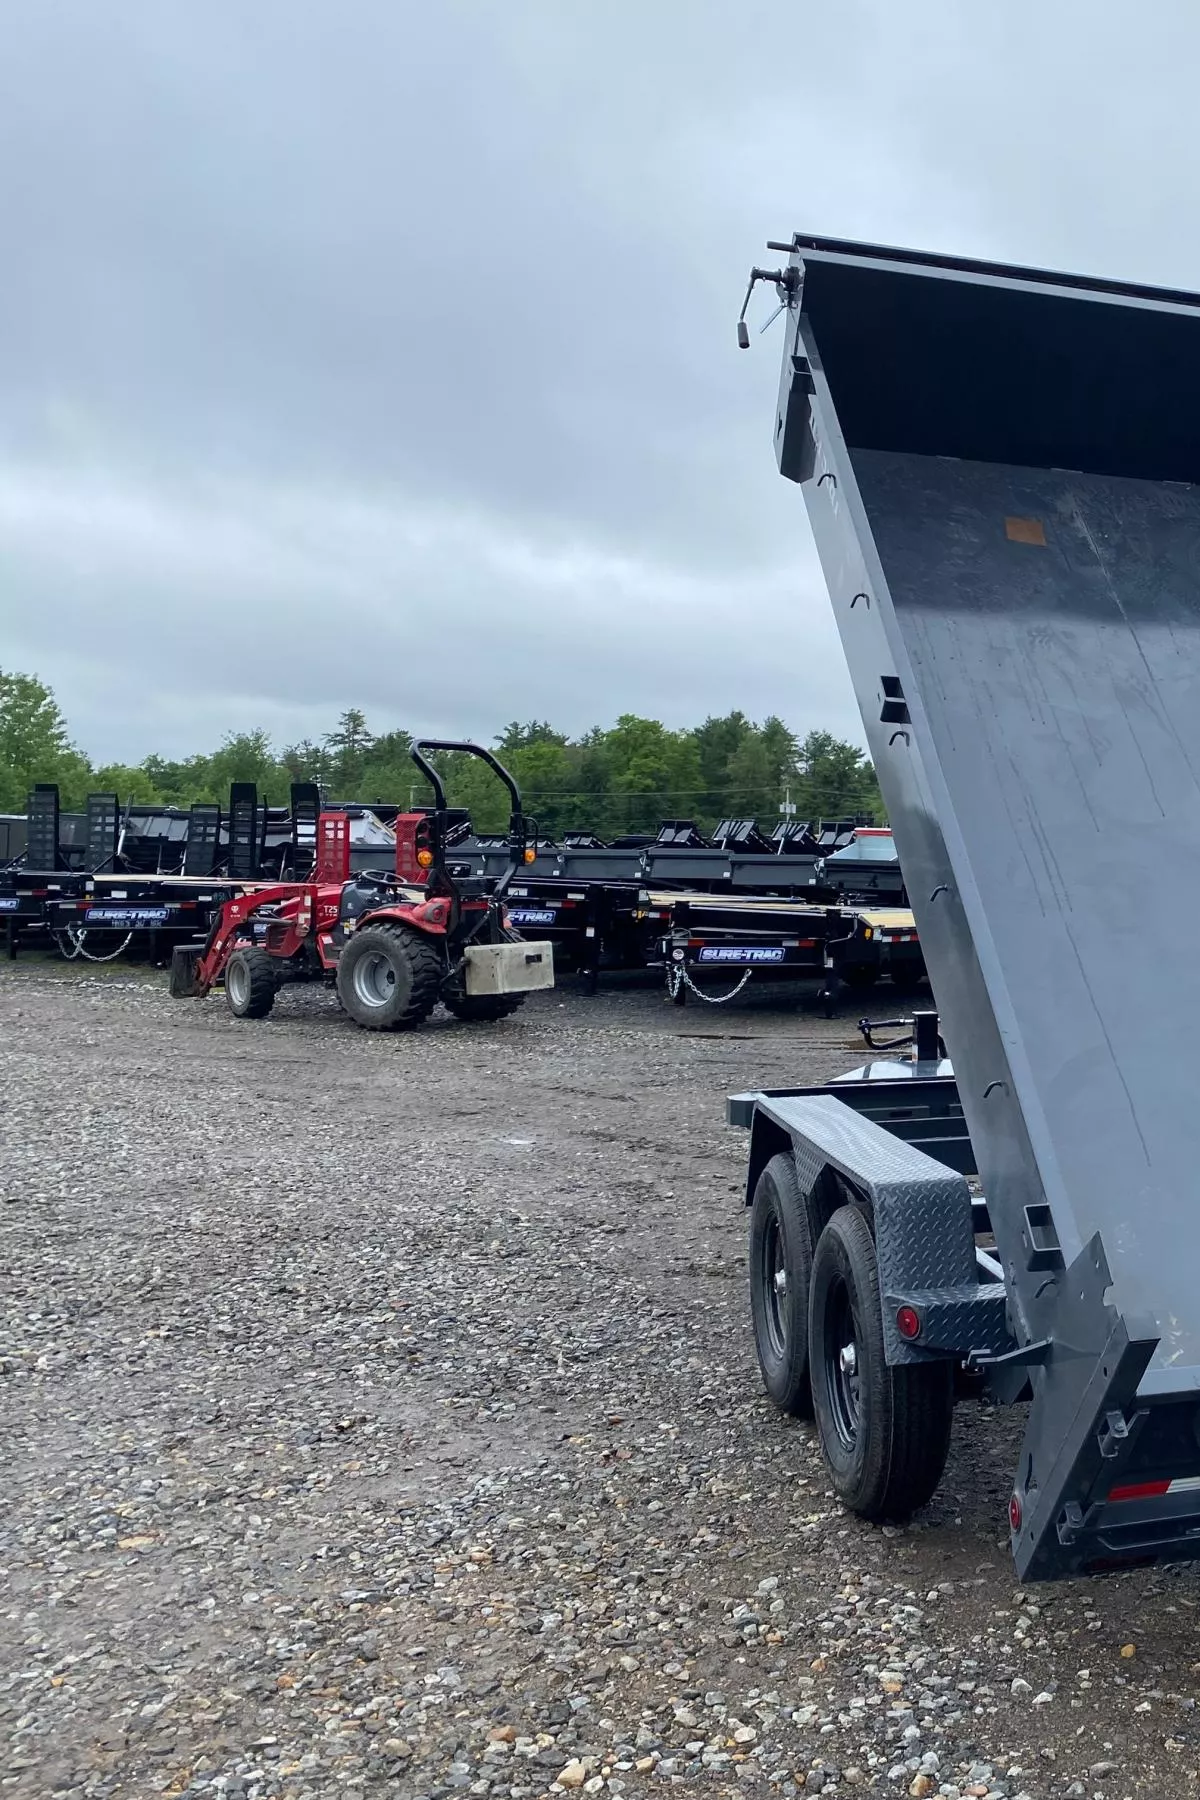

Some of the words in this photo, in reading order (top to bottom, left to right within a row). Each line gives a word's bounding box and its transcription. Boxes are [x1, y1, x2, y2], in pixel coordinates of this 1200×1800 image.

[87, 909, 167, 920] SURE-TRAC
[324, 905, 338, 913] T25
[507, 911, 553, 922] E-TRAC
[701, 949, 783, 960] SURE-TRAC
